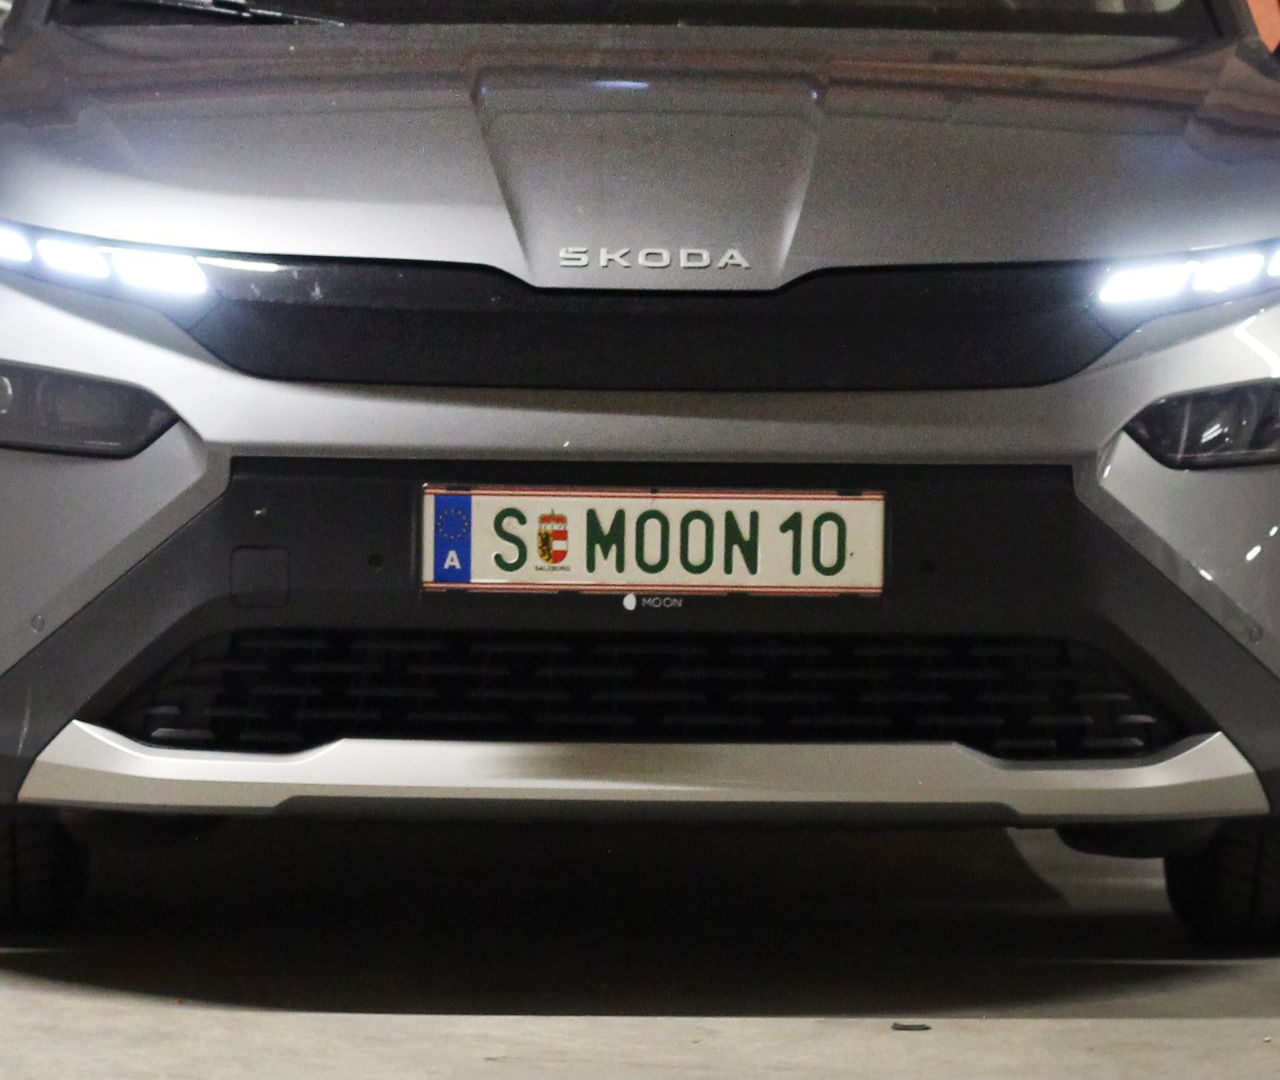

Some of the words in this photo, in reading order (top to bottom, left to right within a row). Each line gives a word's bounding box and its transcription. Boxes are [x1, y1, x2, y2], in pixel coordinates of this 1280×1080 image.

[493, 507, 527, 573] S
[585, 508, 760, 576] MOON
[779, 510, 848, 577] 10
[443, 550, 462, 570] A
[641, 597, 684, 608] MOON
